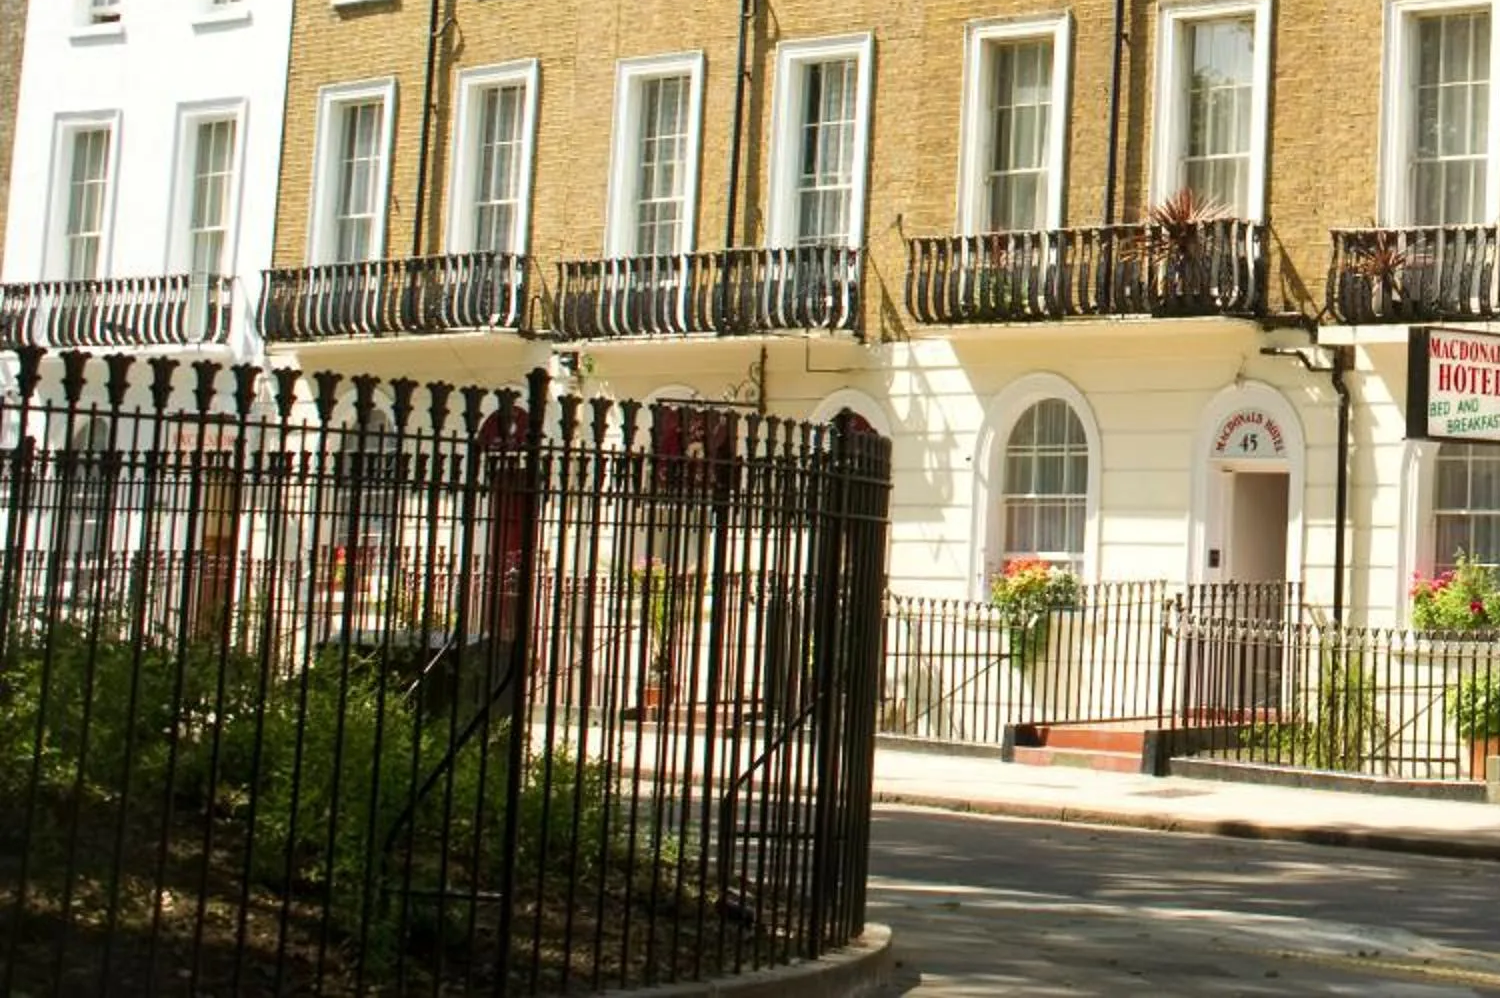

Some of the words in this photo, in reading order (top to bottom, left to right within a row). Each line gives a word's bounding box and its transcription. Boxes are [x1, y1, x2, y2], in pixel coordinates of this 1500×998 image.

[1430, 401, 1450, 417] BED
[1457, 398, 1479, 413] AND
[1239, 433, 1258, 451] 45
